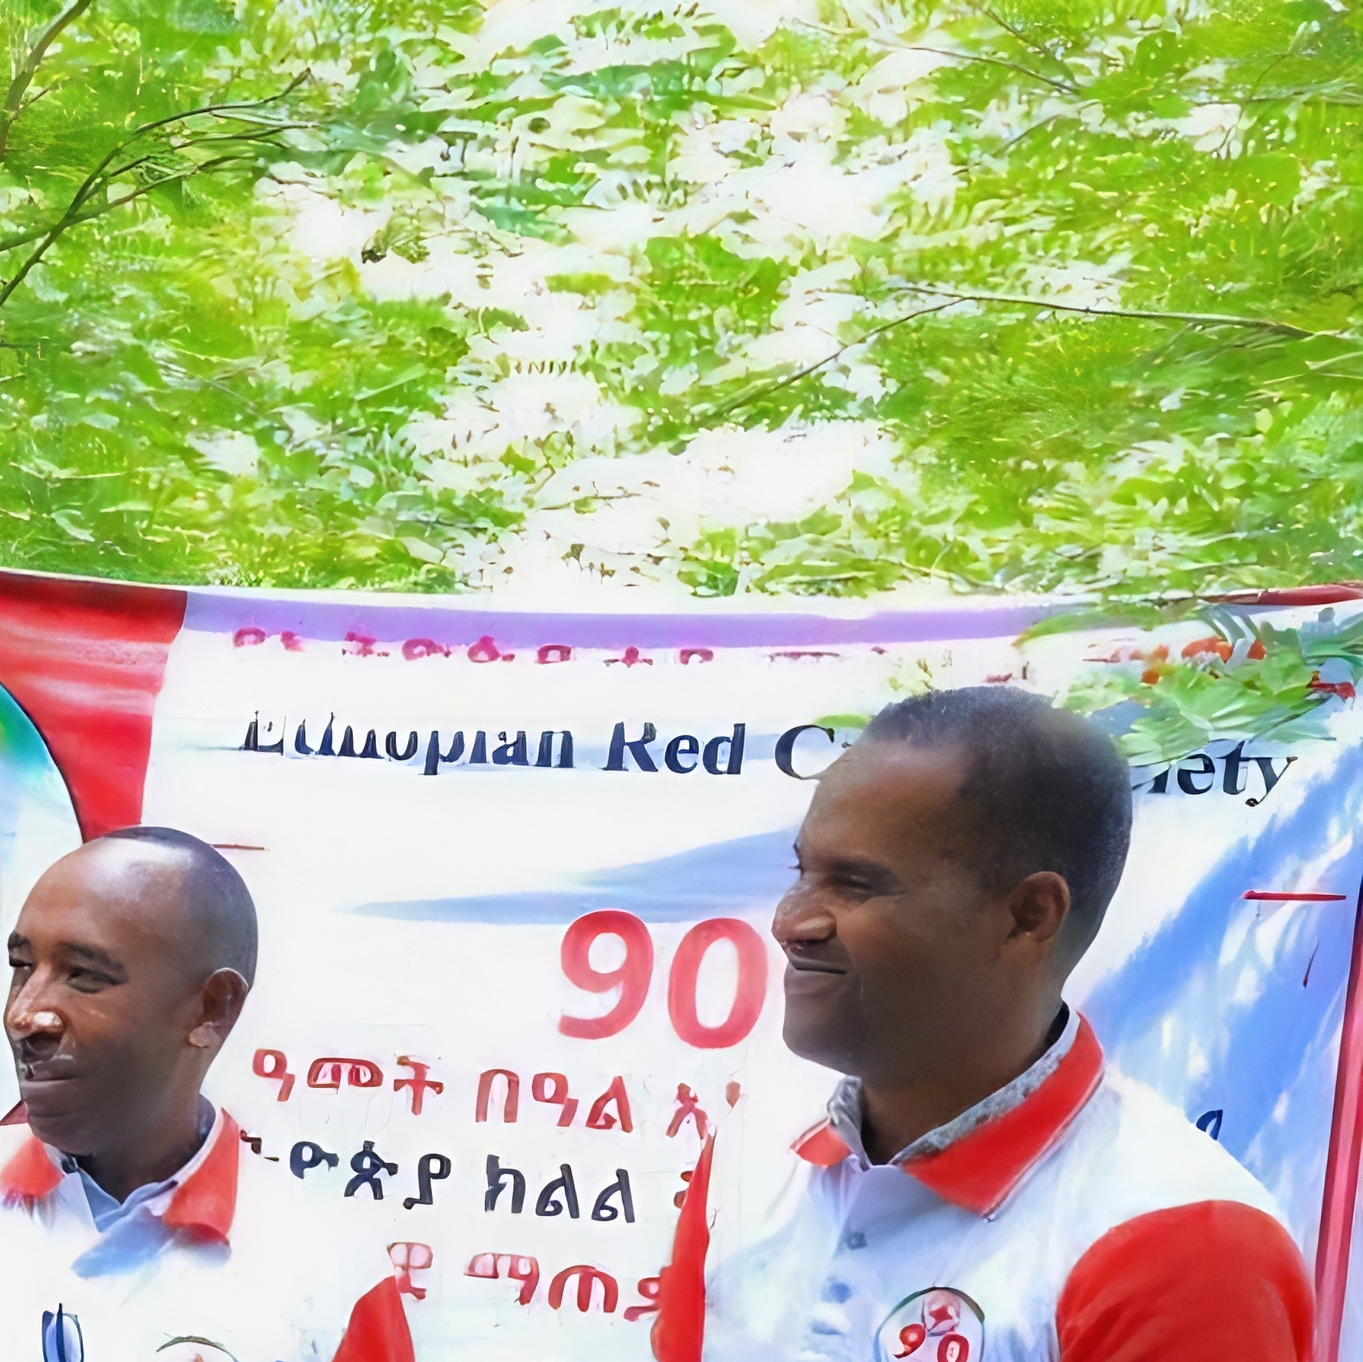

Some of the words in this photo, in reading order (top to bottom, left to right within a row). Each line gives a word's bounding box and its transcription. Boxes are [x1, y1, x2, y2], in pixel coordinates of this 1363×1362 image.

[605, 720, 745, 774] Red
[775, 722, 843, 780] C
[557, 908, 769, 1049] 90
[252, 1049, 444, 1116] ዓመት
[475, 1068, 633, 1133] በዓል
[241, 1130, 452, 1210] ዮጵያ
[484, 1154, 635, 1223] ክልል
